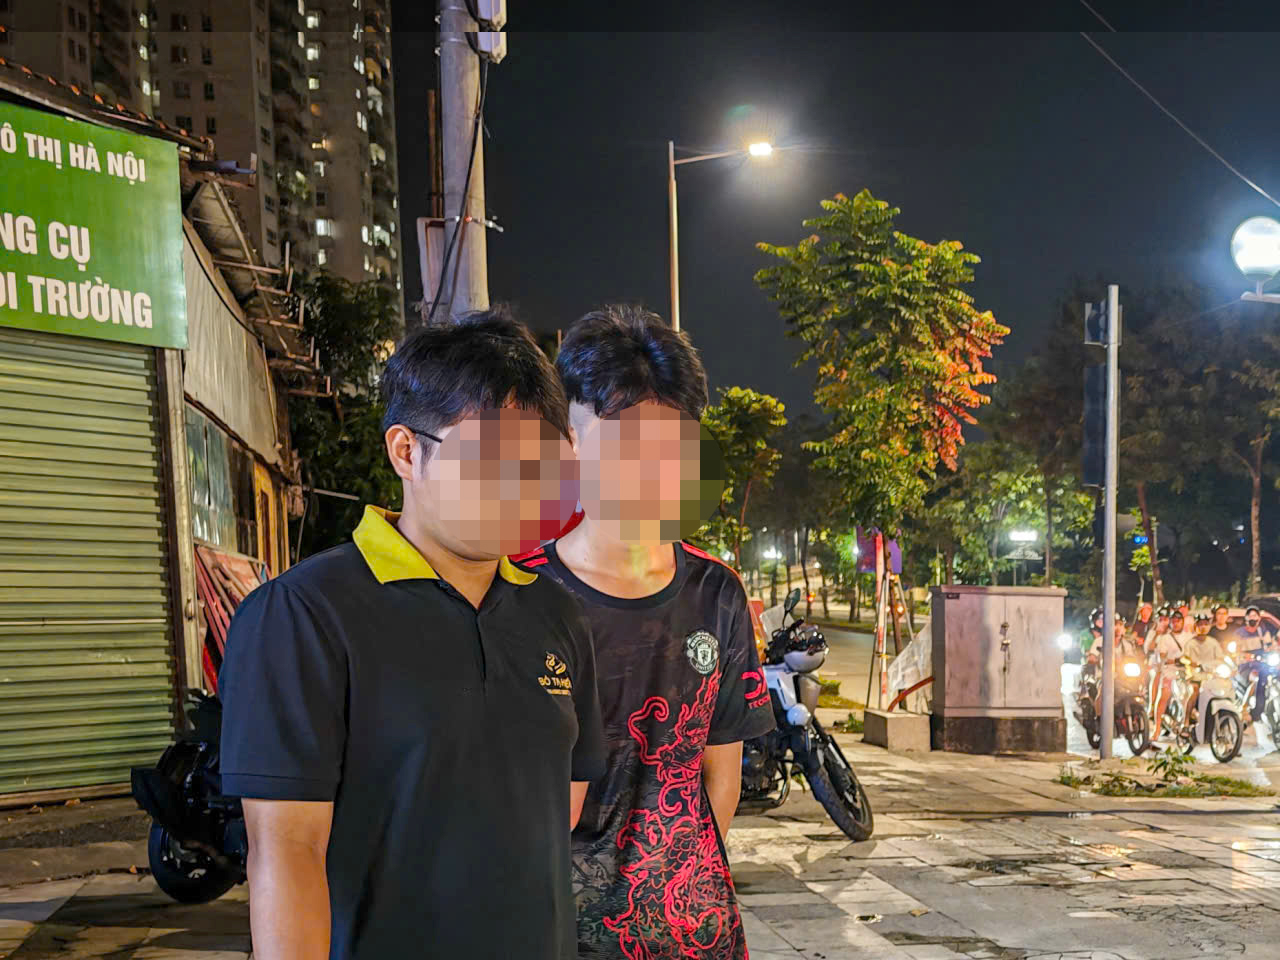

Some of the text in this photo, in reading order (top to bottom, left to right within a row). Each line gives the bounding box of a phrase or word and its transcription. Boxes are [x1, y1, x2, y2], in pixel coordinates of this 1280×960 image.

[23, 132, 62, 169] THỊ
[69, 141, 101, 172] HÀ
[107, 151, 146, 185] NỘI
[48, 221, 91, 272] CỤ
[27, 275, 153, 329] TRƯỜNG
